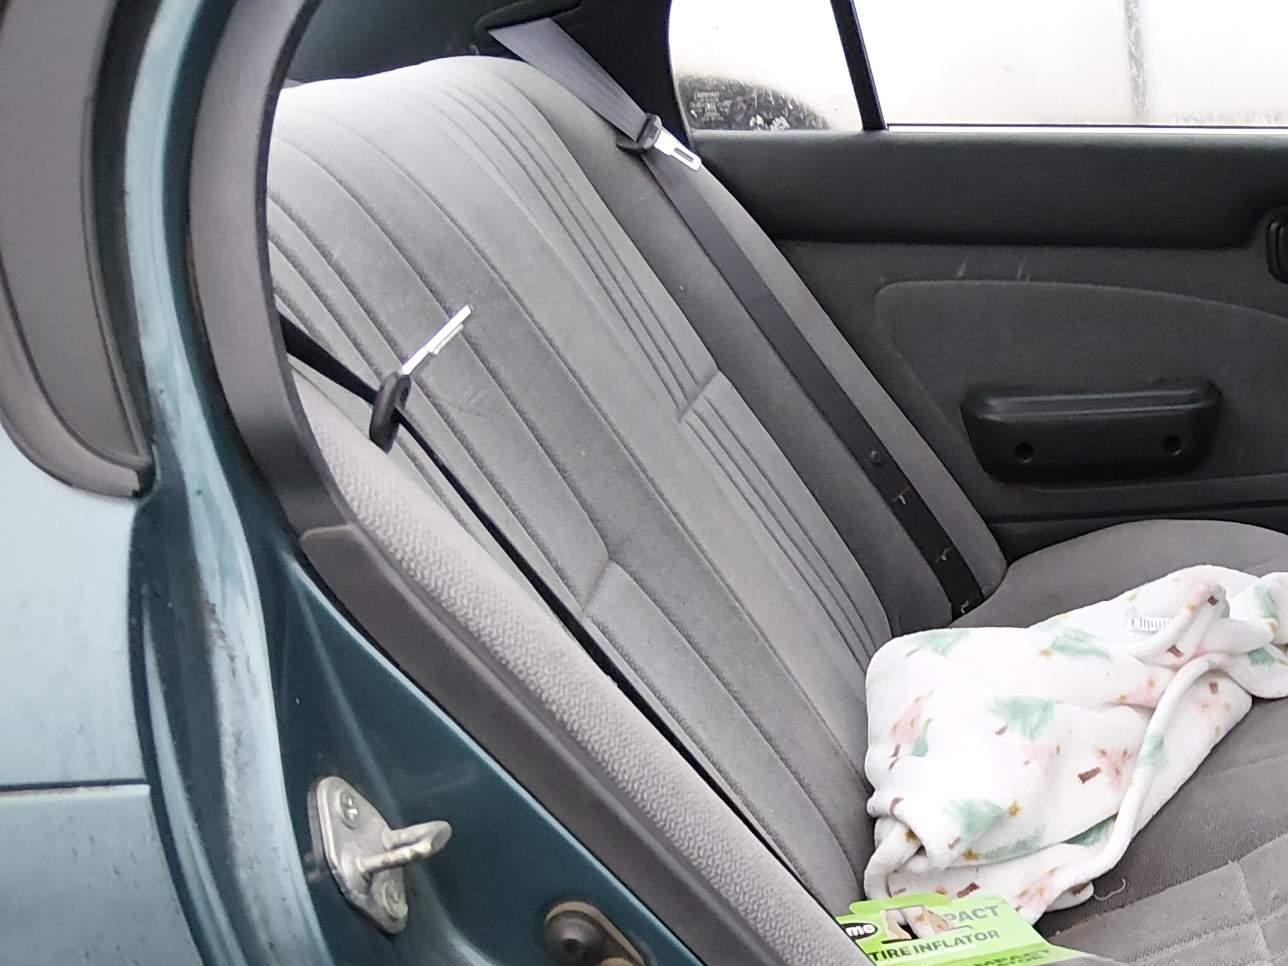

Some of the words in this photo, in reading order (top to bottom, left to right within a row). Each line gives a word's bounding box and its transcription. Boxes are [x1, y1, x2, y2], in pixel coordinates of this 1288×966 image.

[943, 905, 999, 922] PACT
[868, 945, 911, 962] TIRE
[914, 930, 1000, 955] INFLATOR
